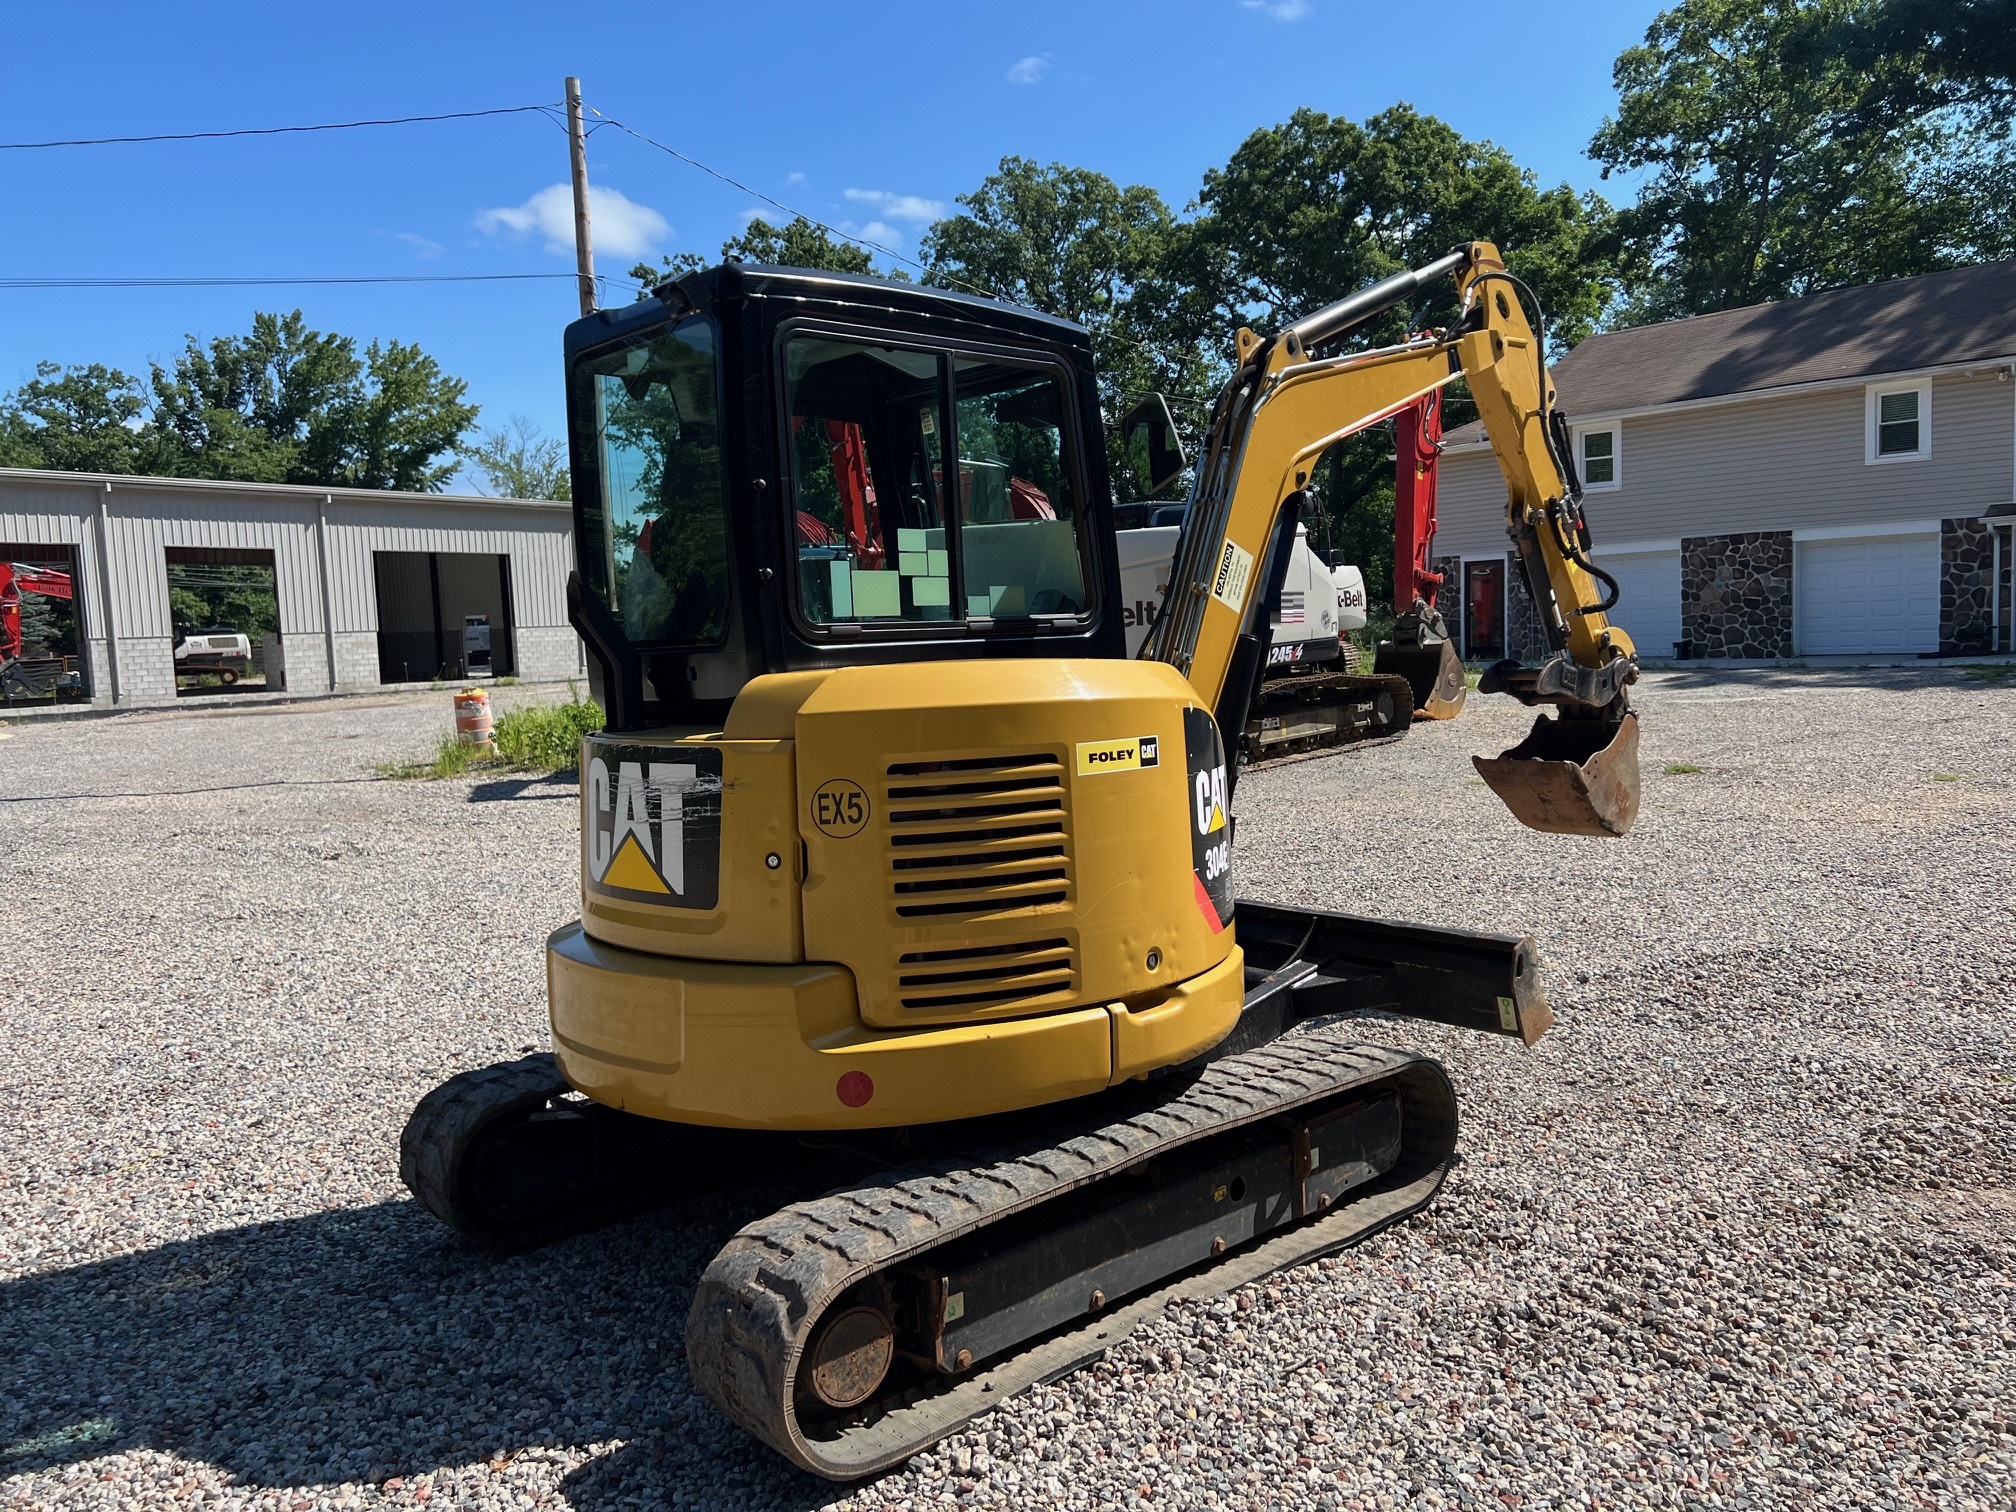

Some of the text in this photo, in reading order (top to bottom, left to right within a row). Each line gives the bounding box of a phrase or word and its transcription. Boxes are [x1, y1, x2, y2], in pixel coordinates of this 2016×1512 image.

[1216, 546, 1233, 594] CAUTION
[1088, 743, 1156, 764] FOLEY CAT
[818, 792, 863, 825] EX5
[1195, 765, 1227, 835] CAT
[589, 757, 697, 896] CAT
